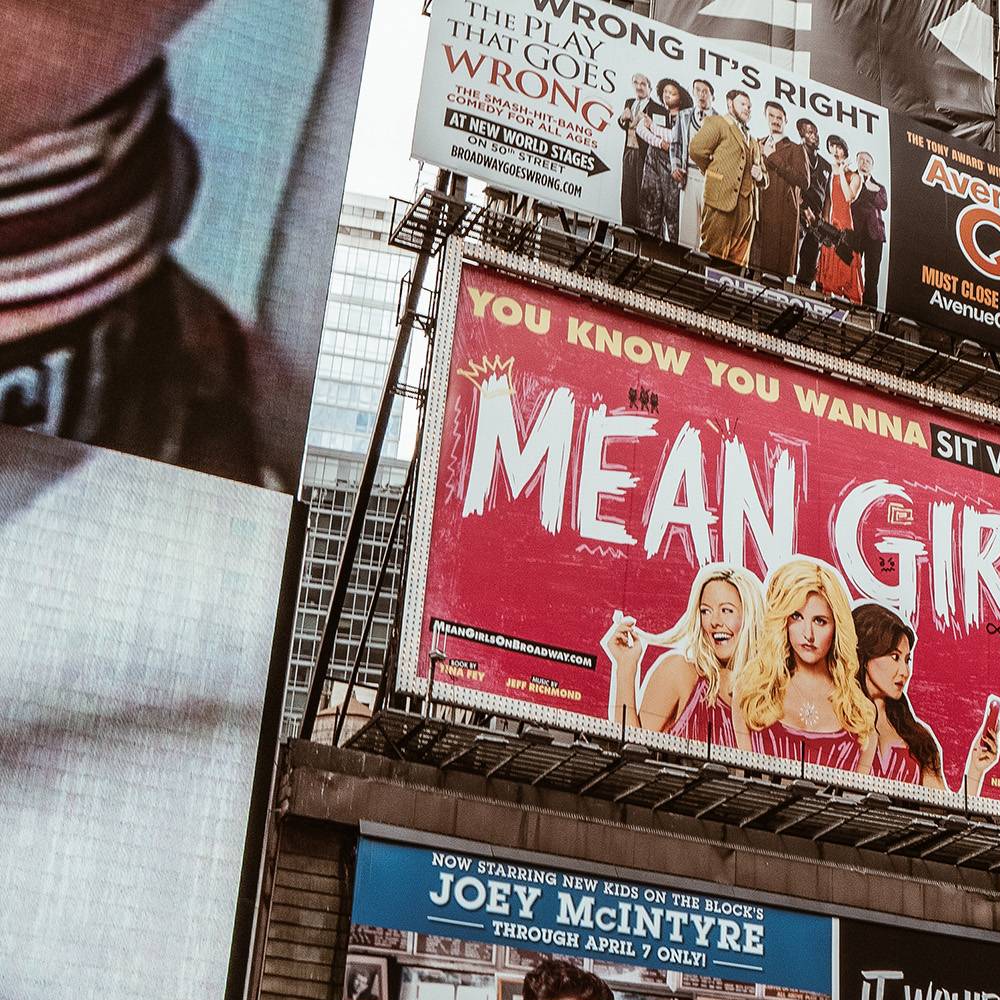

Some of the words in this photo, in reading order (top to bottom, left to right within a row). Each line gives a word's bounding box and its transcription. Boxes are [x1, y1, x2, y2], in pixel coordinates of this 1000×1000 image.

[447, 18, 518, 54] THAT
[524, 43, 616, 93] GOES
[465, 0, 515, 31] THE
[525, 13, 605, 60] PLAY
[442, 44, 614, 132] WRONG
[533, 0, 684, 60] WRONG
[699, 47, 761, 90] IT'S
[775, 76, 879, 135] RIGHT
[447, 94, 503, 116] COMEDY
[508, 111, 535, 128] FOR
[538, 123, 561, 137] ALL
[566, 134, 598, 149] AGES
[456, 85, 480, 99] THE
[485, 92, 593, 137] SMASH-HIT-BANG
[450, 112, 467, 128] AT
[469, 117, 500, 139] NEW
[503, 127, 548, 155] WORLD
[550, 144, 595, 170] STAGES
[468, 136, 487, 150] ON
[518, 153, 566, 174] STREET
[906, 131, 924, 148] THE
[926, 138, 949, 157] TONY
[451, 145, 582, 198] BROADWAYGOESWRONG.COM
[921, 264, 959, 294] MUST
[961, 280, 999, 308] CLOSE
[467, 287, 551, 335] YOU
[567, 316, 691, 376] KNOW
[704, 356, 780, 403] YOU
[793, 384, 928, 449] WANNA
[936, 431, 977, 466] SIT
[462, 373, 797, 572] MEAN
[451, 659, 468, 669] BOOK
[469, 662, 477, 670] BY
[466, 670, 485, 682] FEY
[506, 678, 527, 691] JEFF
[529, 683, 582, 701] RICHMOND
[532, 676, 549, 687] MUSIC
[550, 680, 559, 688] BY
[432, 852, 472, 871] NOW
[477, 860, 557, 886] STARRING
[562, 874, 598, 892] NEW
[603, 882, 639, 899] KIDS
[644, 889, 667, 904] ON
[672, 893, 700, 909] THE
[704, 899, 764, 920] BLOCK'S
[429, 871, 542, 919] JOEY
[556, 890, 764, 956] McINTYRE
[492, 920, 580, 948] THROUGH
[584, 935, 636, 957] APRIL
[641, 943, 651, 959] 7
[657, 946, 706, 968] ONLY!
